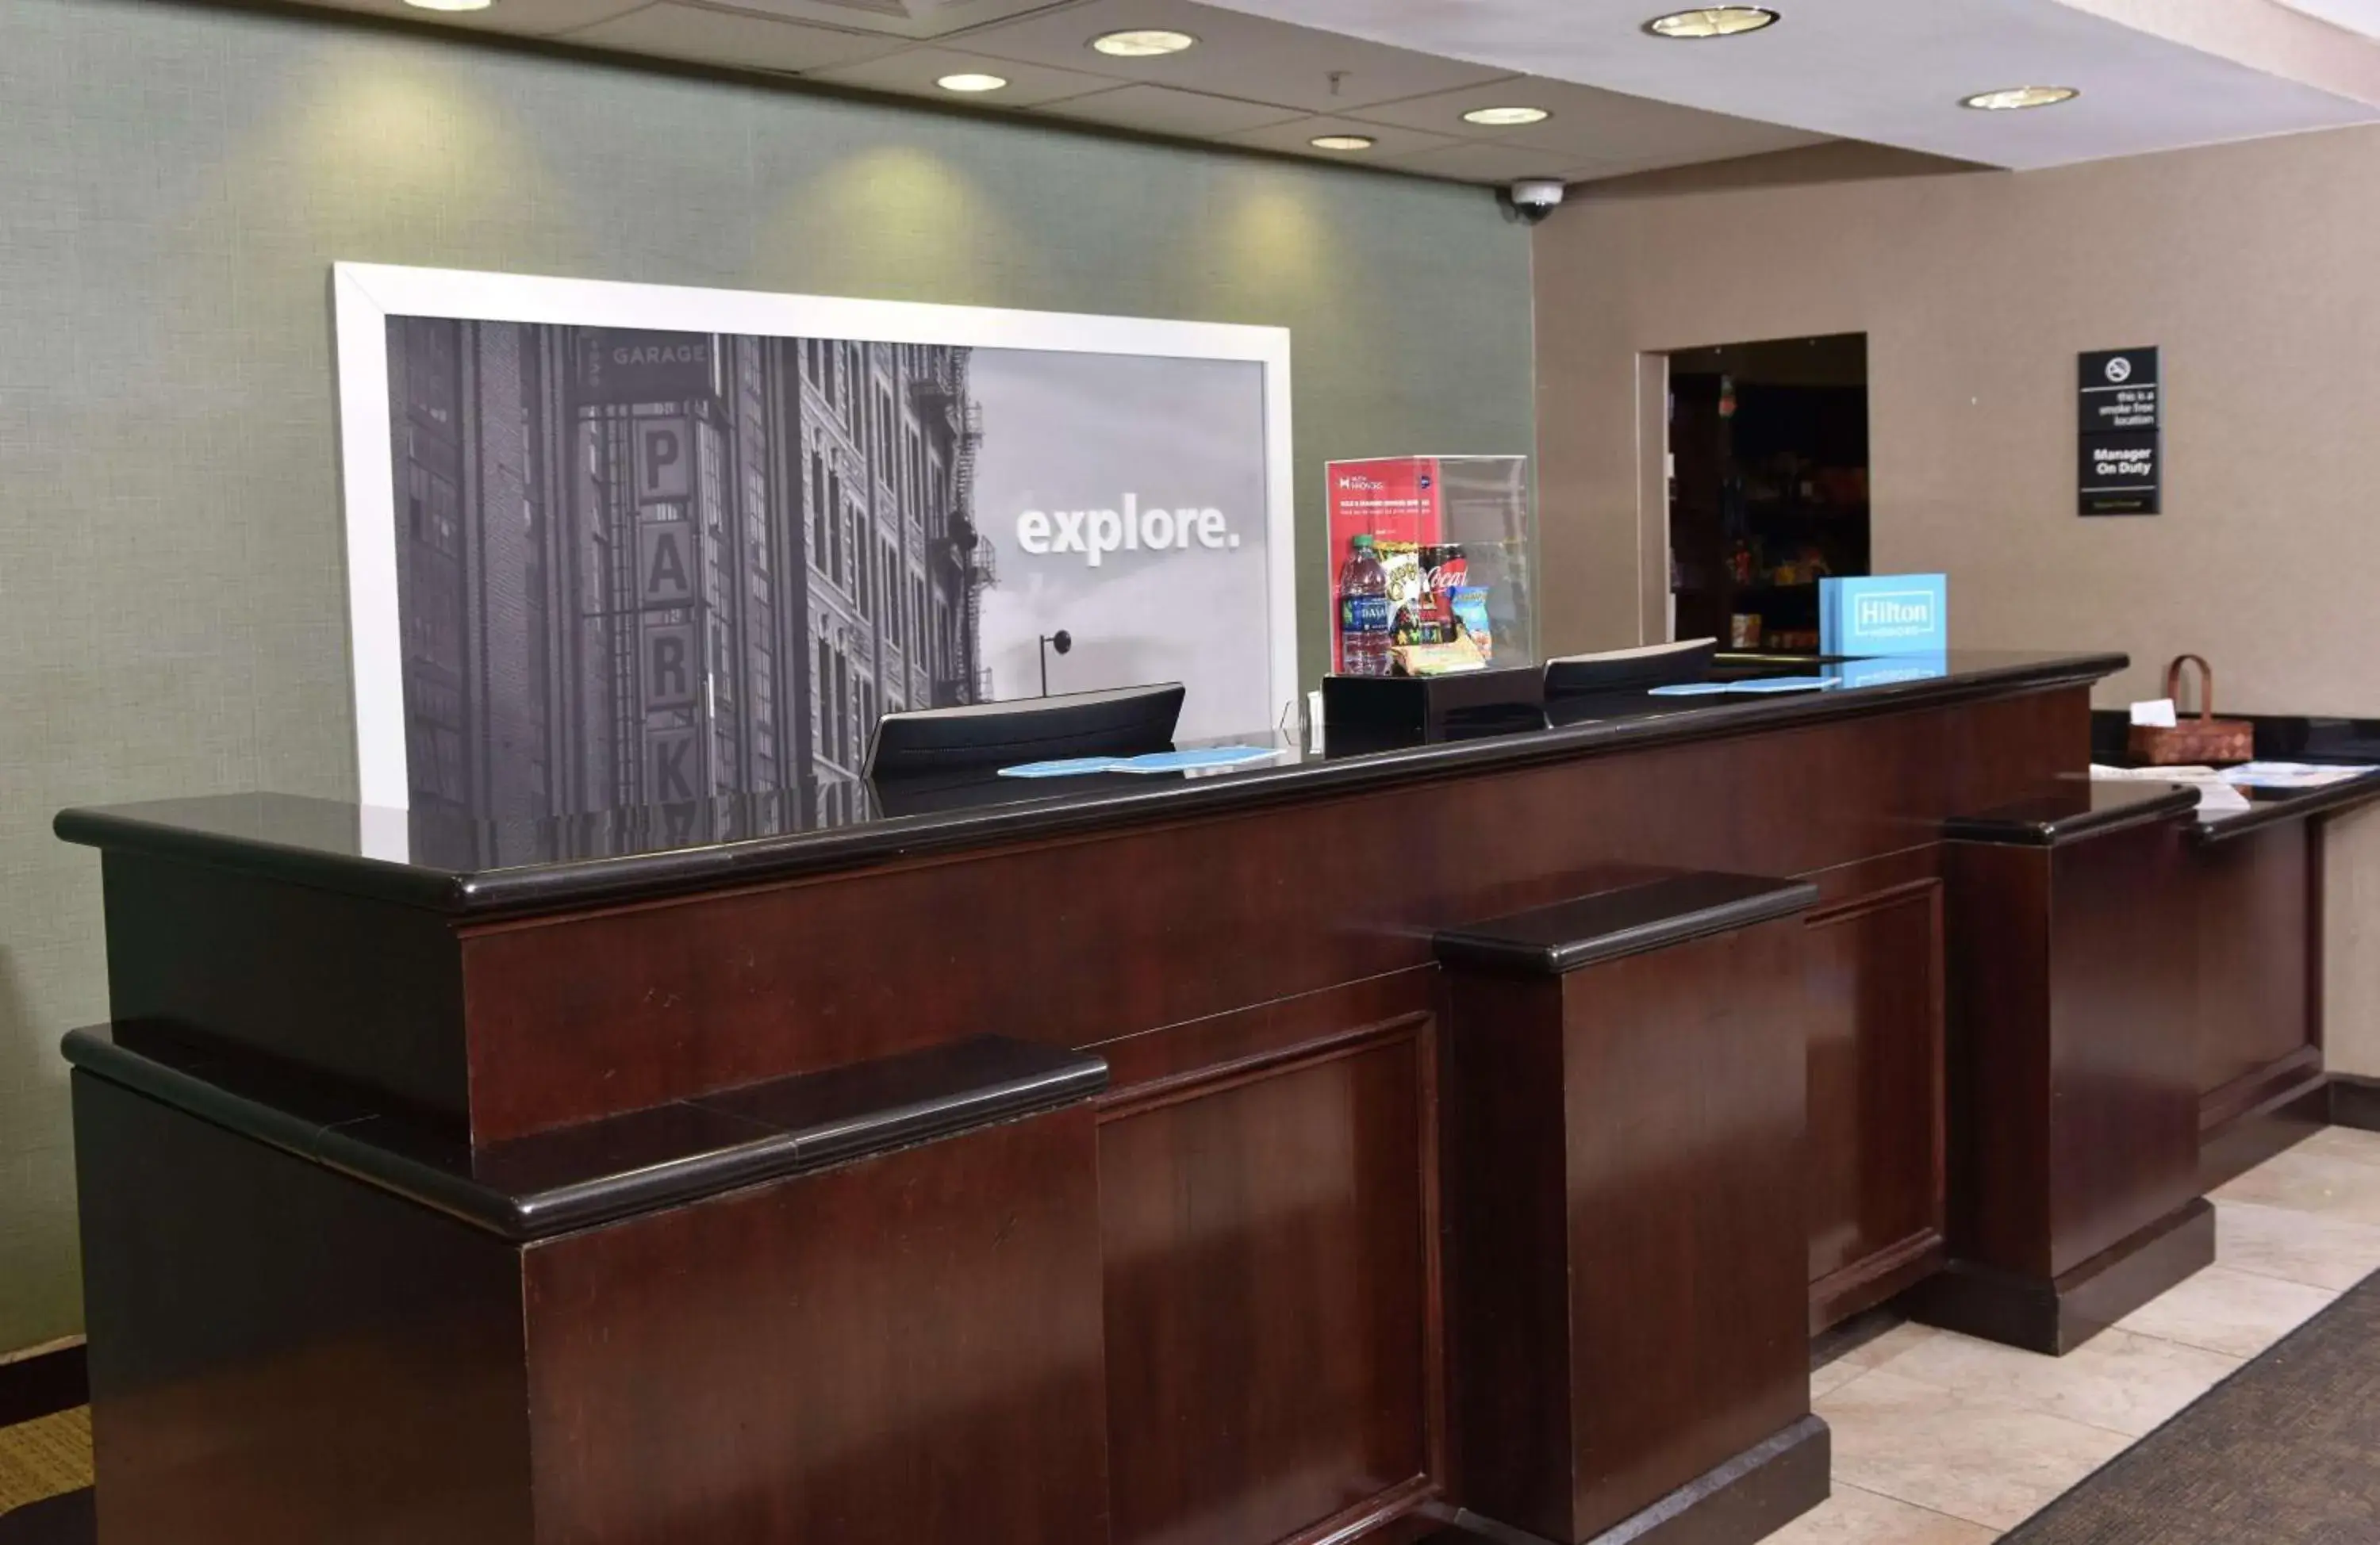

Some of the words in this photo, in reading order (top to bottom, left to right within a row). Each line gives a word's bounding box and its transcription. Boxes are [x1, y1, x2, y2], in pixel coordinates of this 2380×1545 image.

[612, 344, 705, 365] GARAGE
[2117, 392, 2135, 402] this
[2099, 404, 2131, 416] smoke
[2133, 402, 2154, 413] free
[2114, 415, 2154, 426] location
[2094, 449, 2152, 462] Manager
[2096, 462, 2117, 474] On
[2119, 461, 2152, 476] Duty
[1016, 493, 1240, 567] explore.
[645, 429, 691, 801] PARK
[1861, 600, 1927, 624] Hilton
